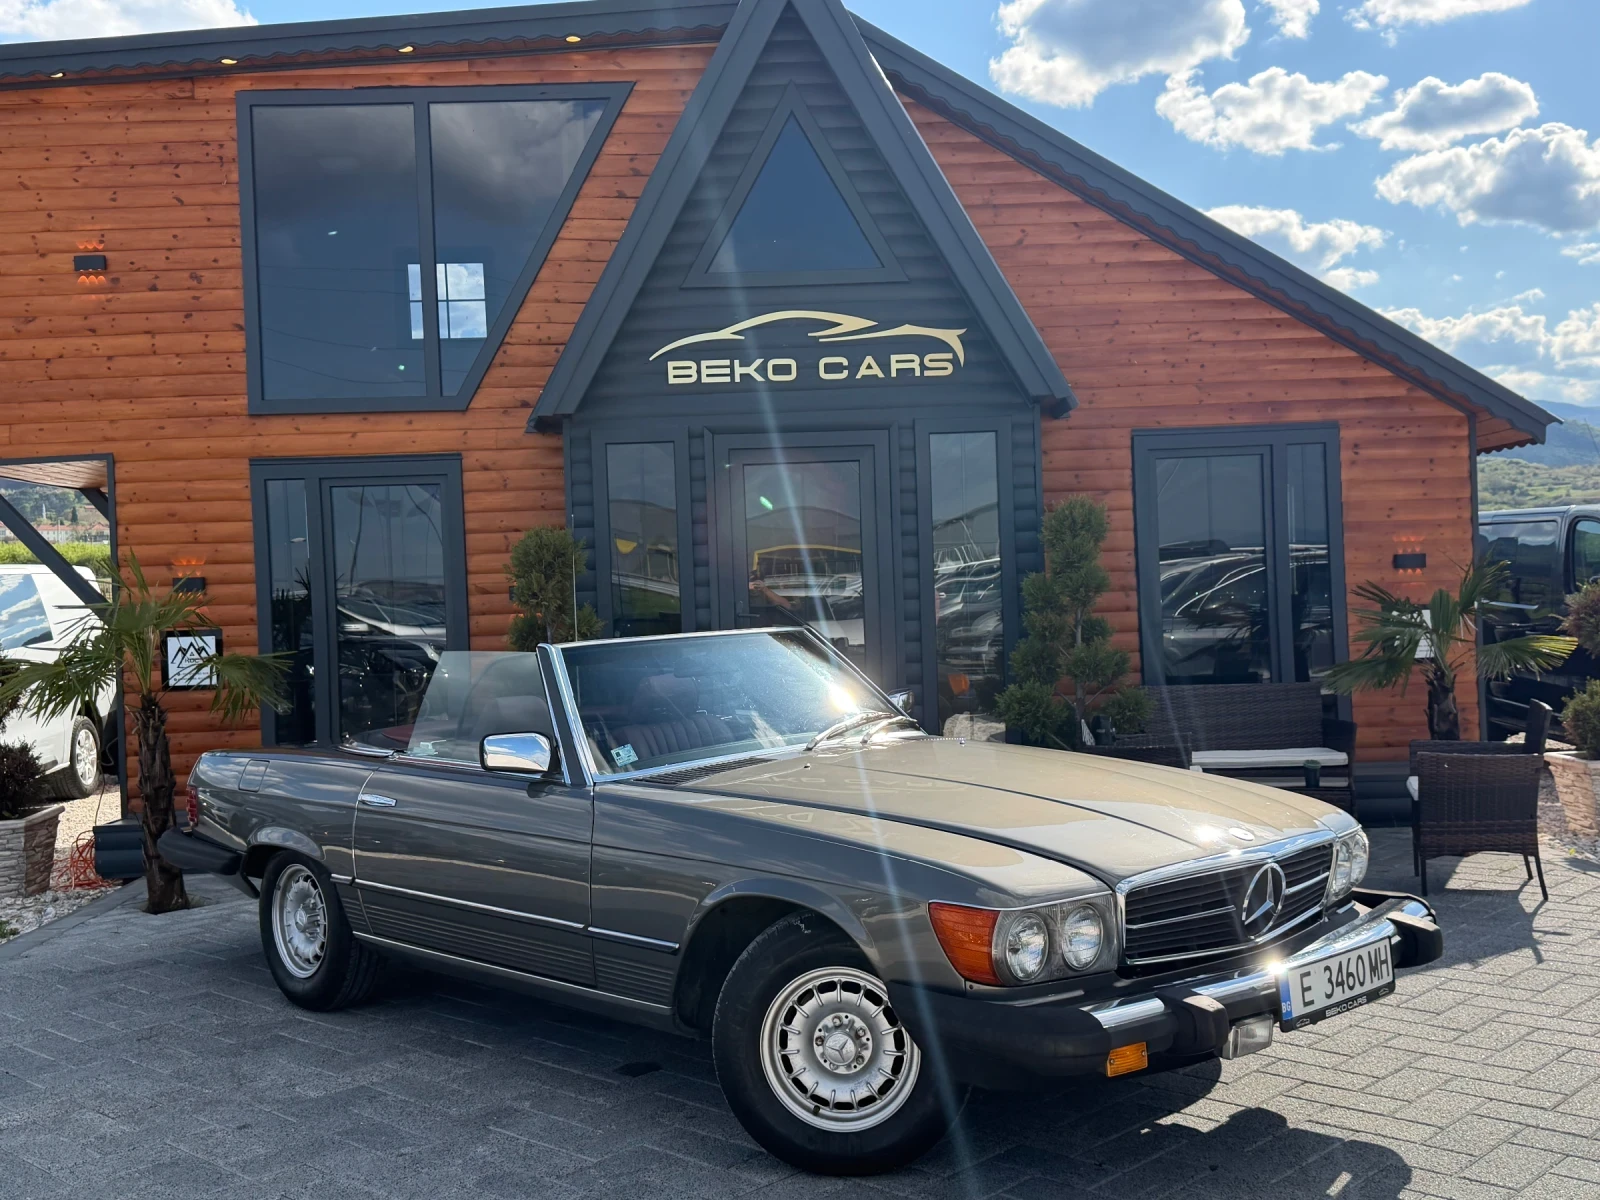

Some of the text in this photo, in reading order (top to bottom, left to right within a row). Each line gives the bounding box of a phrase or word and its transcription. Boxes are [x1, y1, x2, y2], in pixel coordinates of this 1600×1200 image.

[667, 353, 953, 384] BEKO CARS
[1300, 945, 1389, 1007] E 3460 MH
[1281, 1001, 1291, 1013] BG
[1325, 996, 1367, 1017] BEKO CARS
